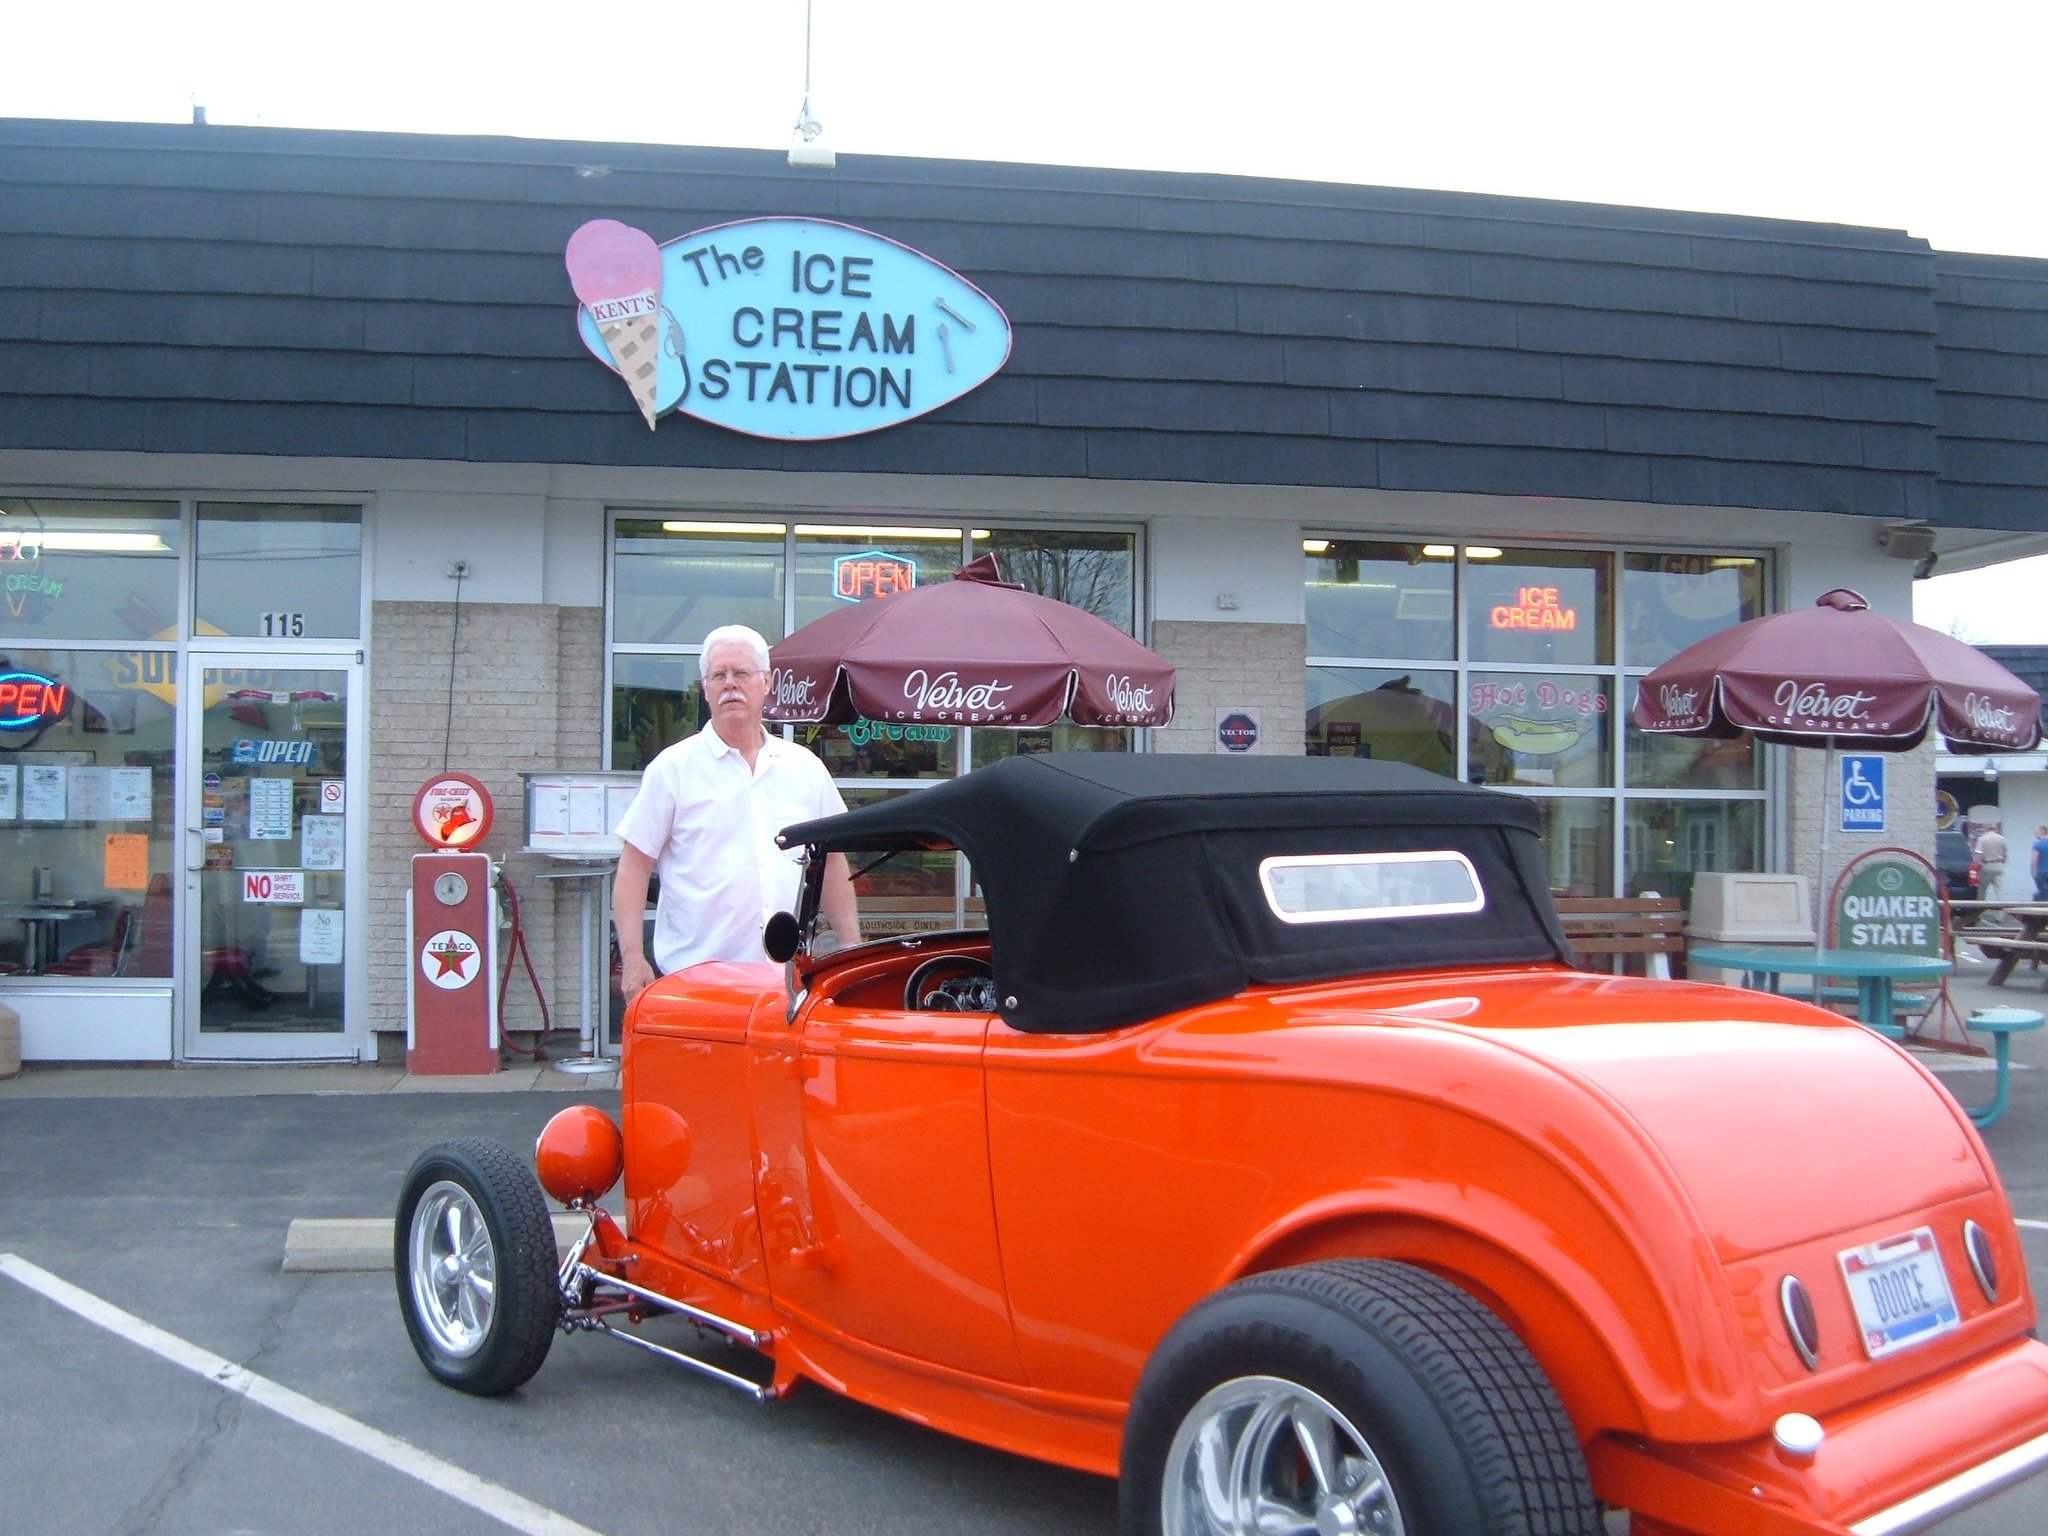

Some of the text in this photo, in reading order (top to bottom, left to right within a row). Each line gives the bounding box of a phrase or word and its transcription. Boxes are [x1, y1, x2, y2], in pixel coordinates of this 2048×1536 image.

[683, 245, 873, 298] The ICE
[593, 294, 657, 321] KENT'S
[733, 307, 915, 355] CREAM
[699, 358, 912, 409] STATION
[839, 561, 912, 598] OPEN
[1519, 586, 1559, 608] ICE
[264, 612, 304, 637] 115
[1490, 606, 1577, 631] CREAM
[771, 667, 817, 707] Velvet
[903, 669, 1014, 711] Velvet
[1105, 673, 1154, 713] Velvet
[1469, 680, 1608, 716] Hot Dogs
[1774, 680, 1878, 720] Velvet
[1660, 684, 1699, 719] Velvet
[1964, 692, 2016, 732] Velvet
[885, 711, 1028, 721] ICE CREAMS
[838, 714, 952, 746] Cream
[1220, 728, 1257, 737] VECTOR
[257, 741, 313, 763] OPEN
[1843, 808, 1883, 823] PARKING
[246, 874, 271, 899] NO
[273, 883, 297, 891] SHOES
[1843, 895, 1935, 921] QUAKER
[431, 942, 473, 951] TEXACO
[1850, 923, 1928, 946] STATE
